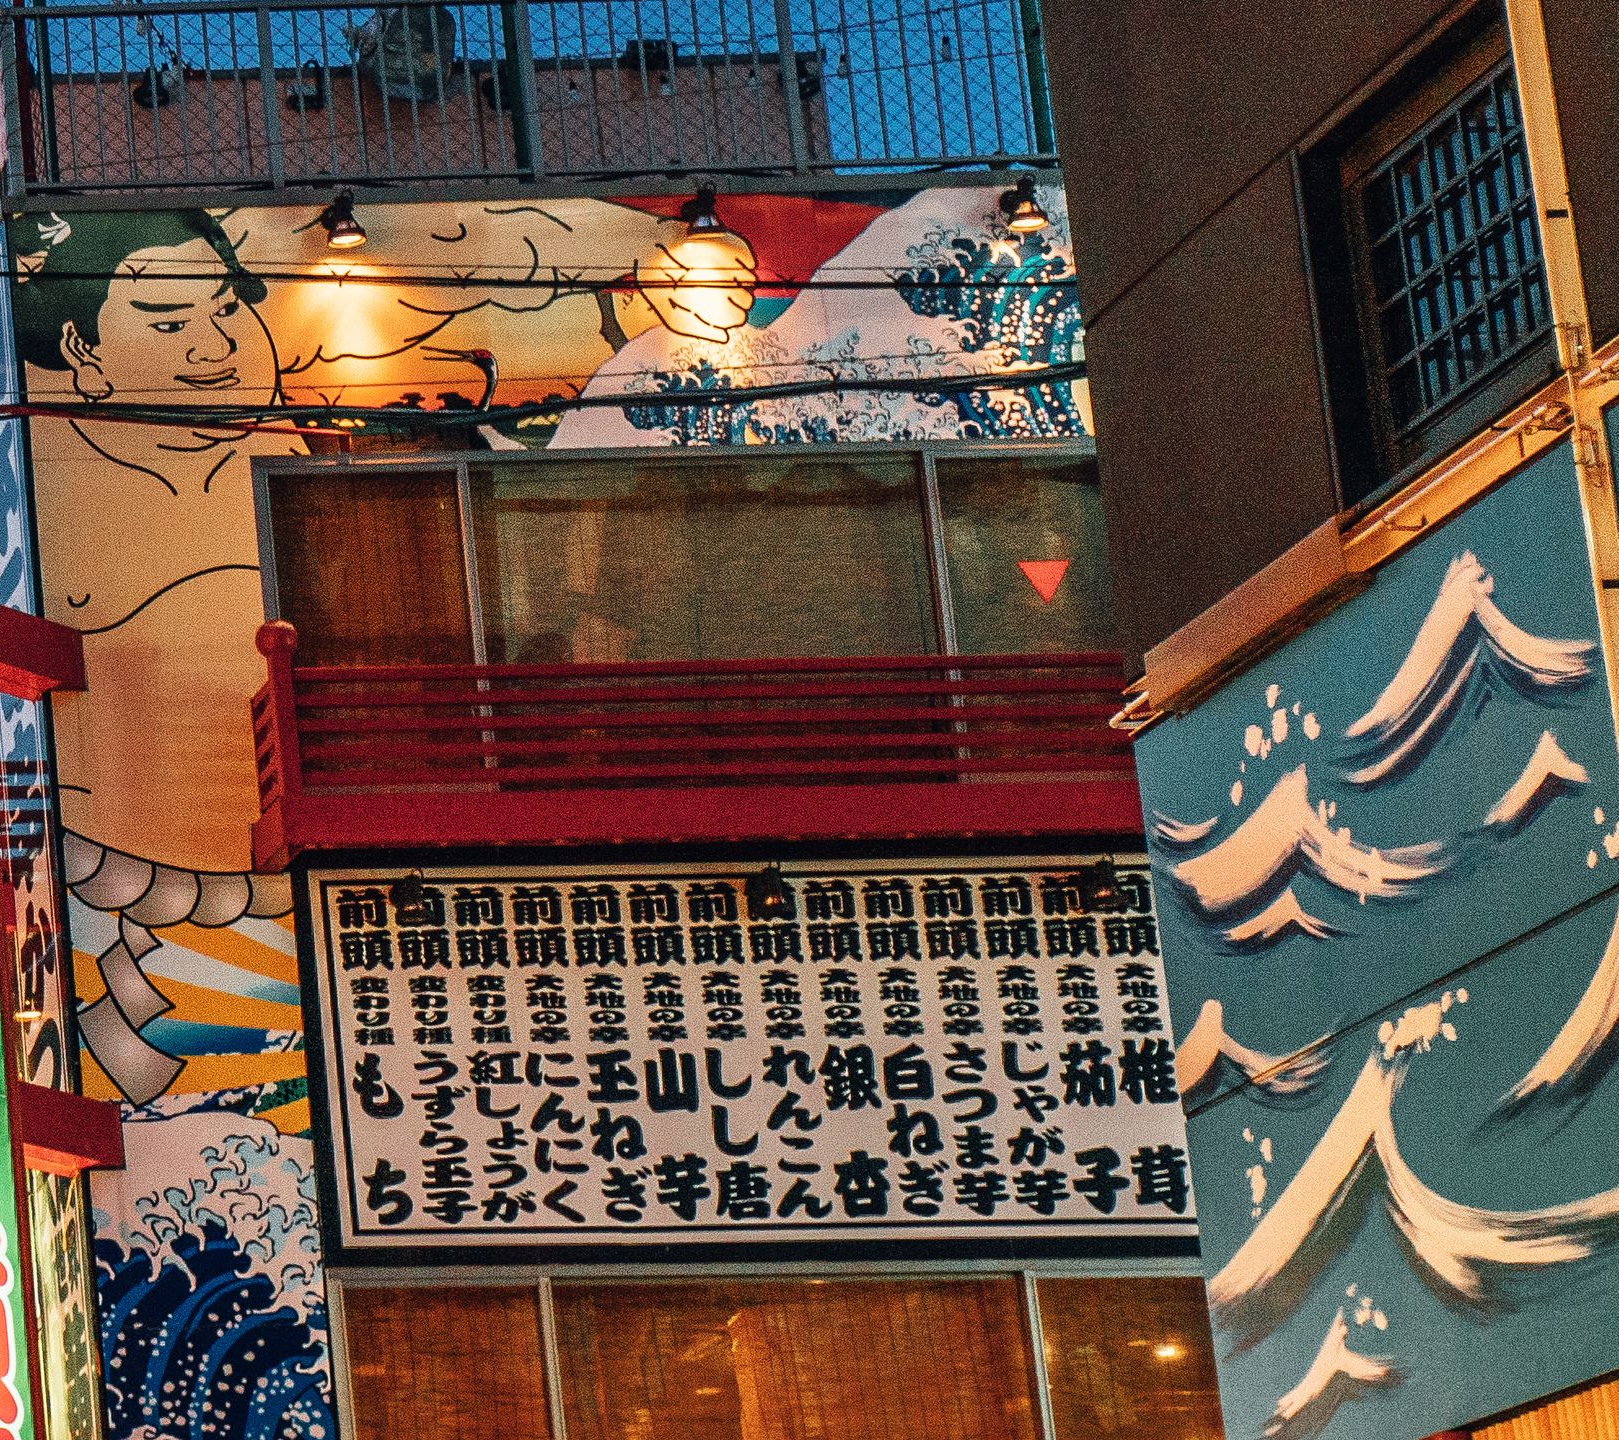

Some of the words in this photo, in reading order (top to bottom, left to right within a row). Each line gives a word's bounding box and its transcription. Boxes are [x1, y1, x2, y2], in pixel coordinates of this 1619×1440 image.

[337, 887, 392, 969] 前頭
[452, 887, 510, 968] 前頭
[510, 885, 569, 967] 前頭
[569, 885, 628, 966] 前頭
[628, 883, 686, 966] 前頭
[686, 882, 745, 965] 前頭
[804, 879, 862, 961] 前頭
[863, 878, 922, 961] 前頭
[922, 877, 981, 960] 前頭
[980, 876, 1040, 959] 前頭
[351, 976, 394, 1045] 変わり種
[409, 975, 452, 1044] 変わり種
[467, 975, 511, 1043] 変わり種
[526, 974, 570, 1043] 大地の幸
[584, 974, 629, 1042] 大地の幸
[643, 972, 687, 1041] 大地の幸
[702, 971, 747, 1040] 大地の幸
[761, 970, 805, 1039] 大地の幸
[819, 969, 864, 1038] 大地の幸
[879, 968, 924, 1037] 大地の幸
[938, 966, 983, 1036] 大地の幸
[997, 966, 1043, 1035] 大地の幸
[1056, 964, 1102, 1034] 大地の幸
[1116, 963, 1163, 1033] 大地の幸
[353, 1052, 413, 1224] もち
[412, 1051, 477, 1223] うずら玉子
[468, 1051, 537, 1222] 紅しょうが
[527, 1053, 589, 1222] にんにく
[587, 1050, 652, 1222] 玉ねぎ
[646, 1048, 711, 1221] 山芋
[705, 1048, 772, 1220] しし唐
[763, 1047, 832, 1218] れんこん
[819, 1045, 890, 1217] 銀杏
[884, 1044, 949, 1215] 白ねぎ
[943, 1043, 1011, 1216] さつま芋
[1060, 1040, 1129, 1214] 茄子
[1119, 1039, 1188, 1214] 椎茸
